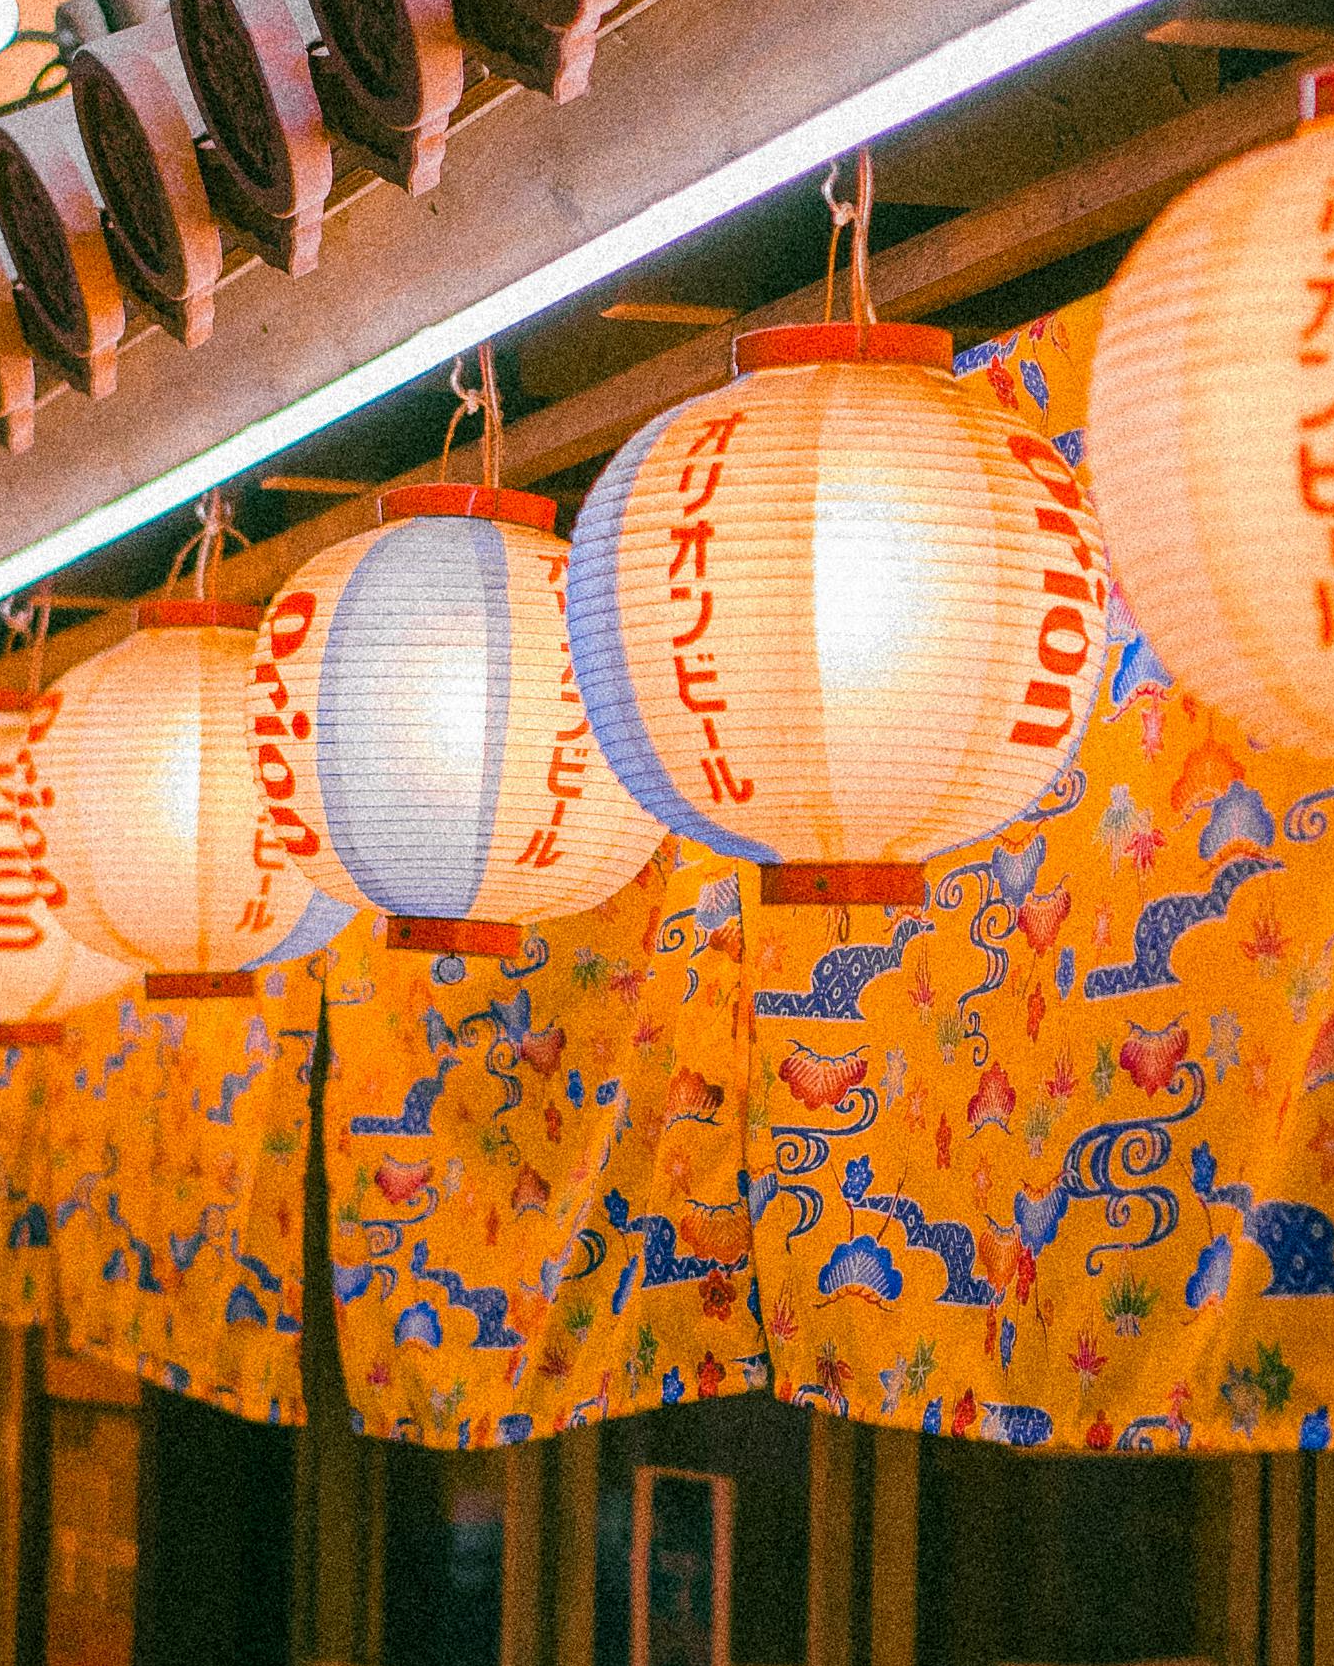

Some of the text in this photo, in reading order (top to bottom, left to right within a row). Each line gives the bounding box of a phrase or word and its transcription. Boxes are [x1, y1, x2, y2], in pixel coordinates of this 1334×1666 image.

[253, 591, 321, 858] Orion
[668, 411, 755, 806] オリオンビール
[1006, 434, 1107, 749] Orion
